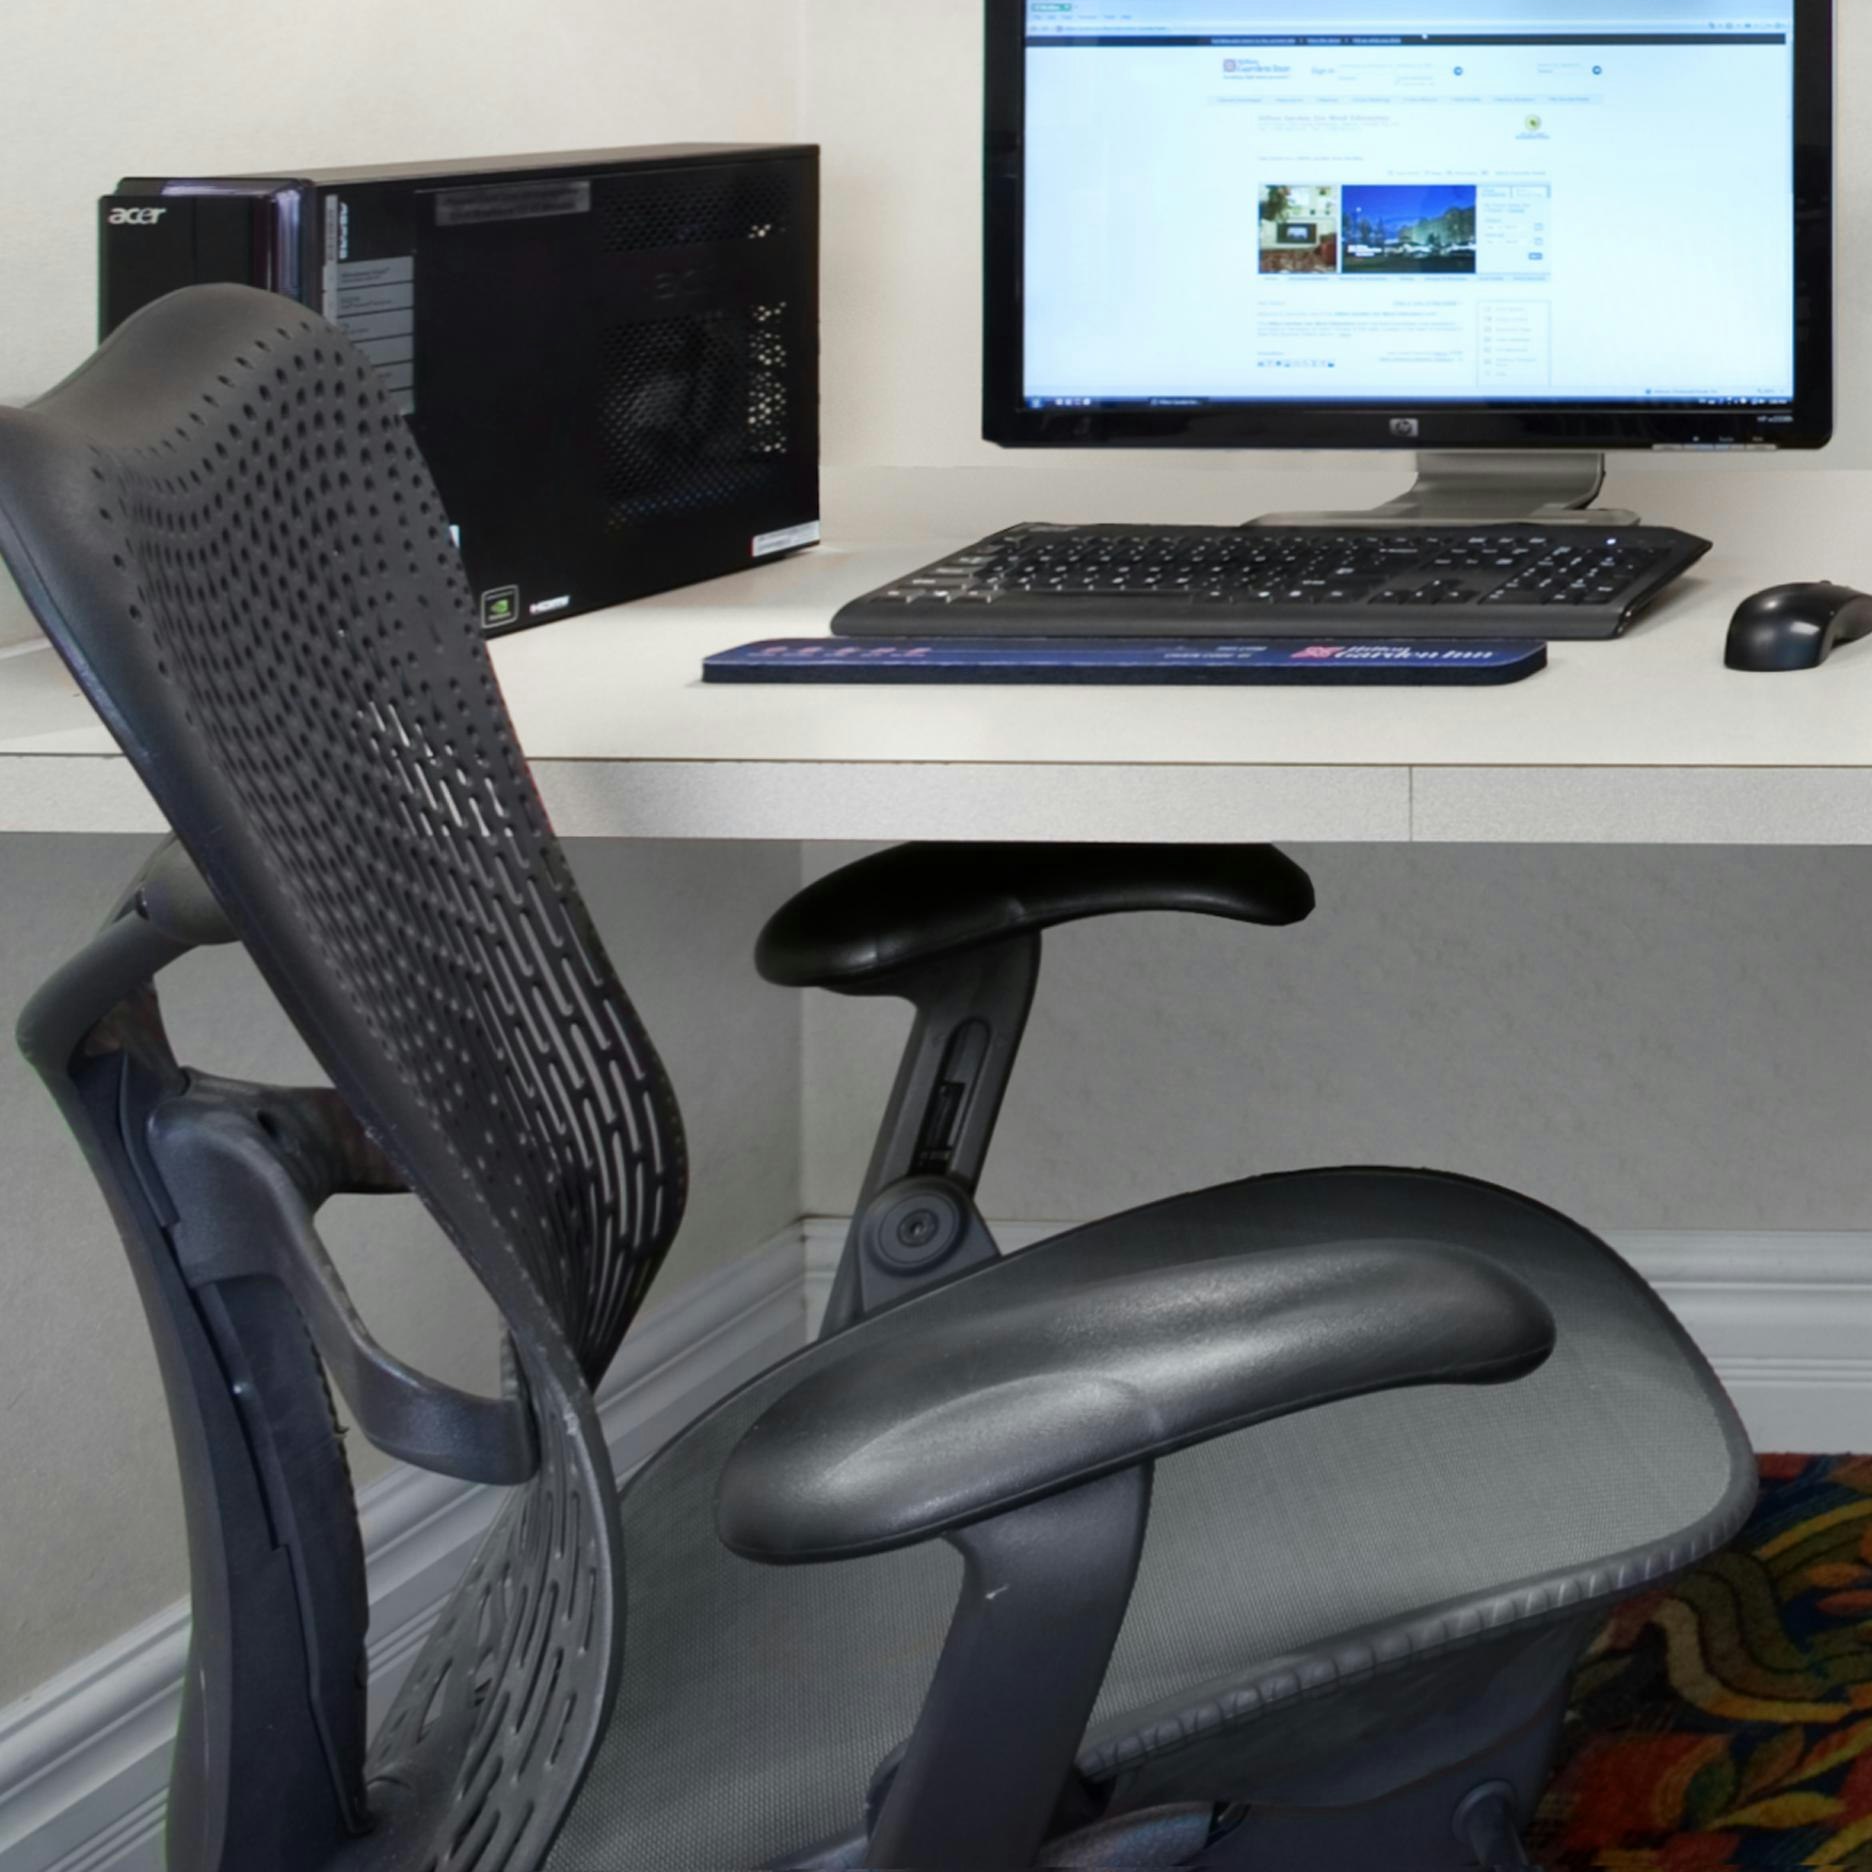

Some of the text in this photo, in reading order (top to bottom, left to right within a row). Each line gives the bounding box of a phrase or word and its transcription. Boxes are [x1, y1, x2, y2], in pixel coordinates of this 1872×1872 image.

[108, 207, 167, 225] acer
[1335, 647, 1493, 659] Garden Inn
